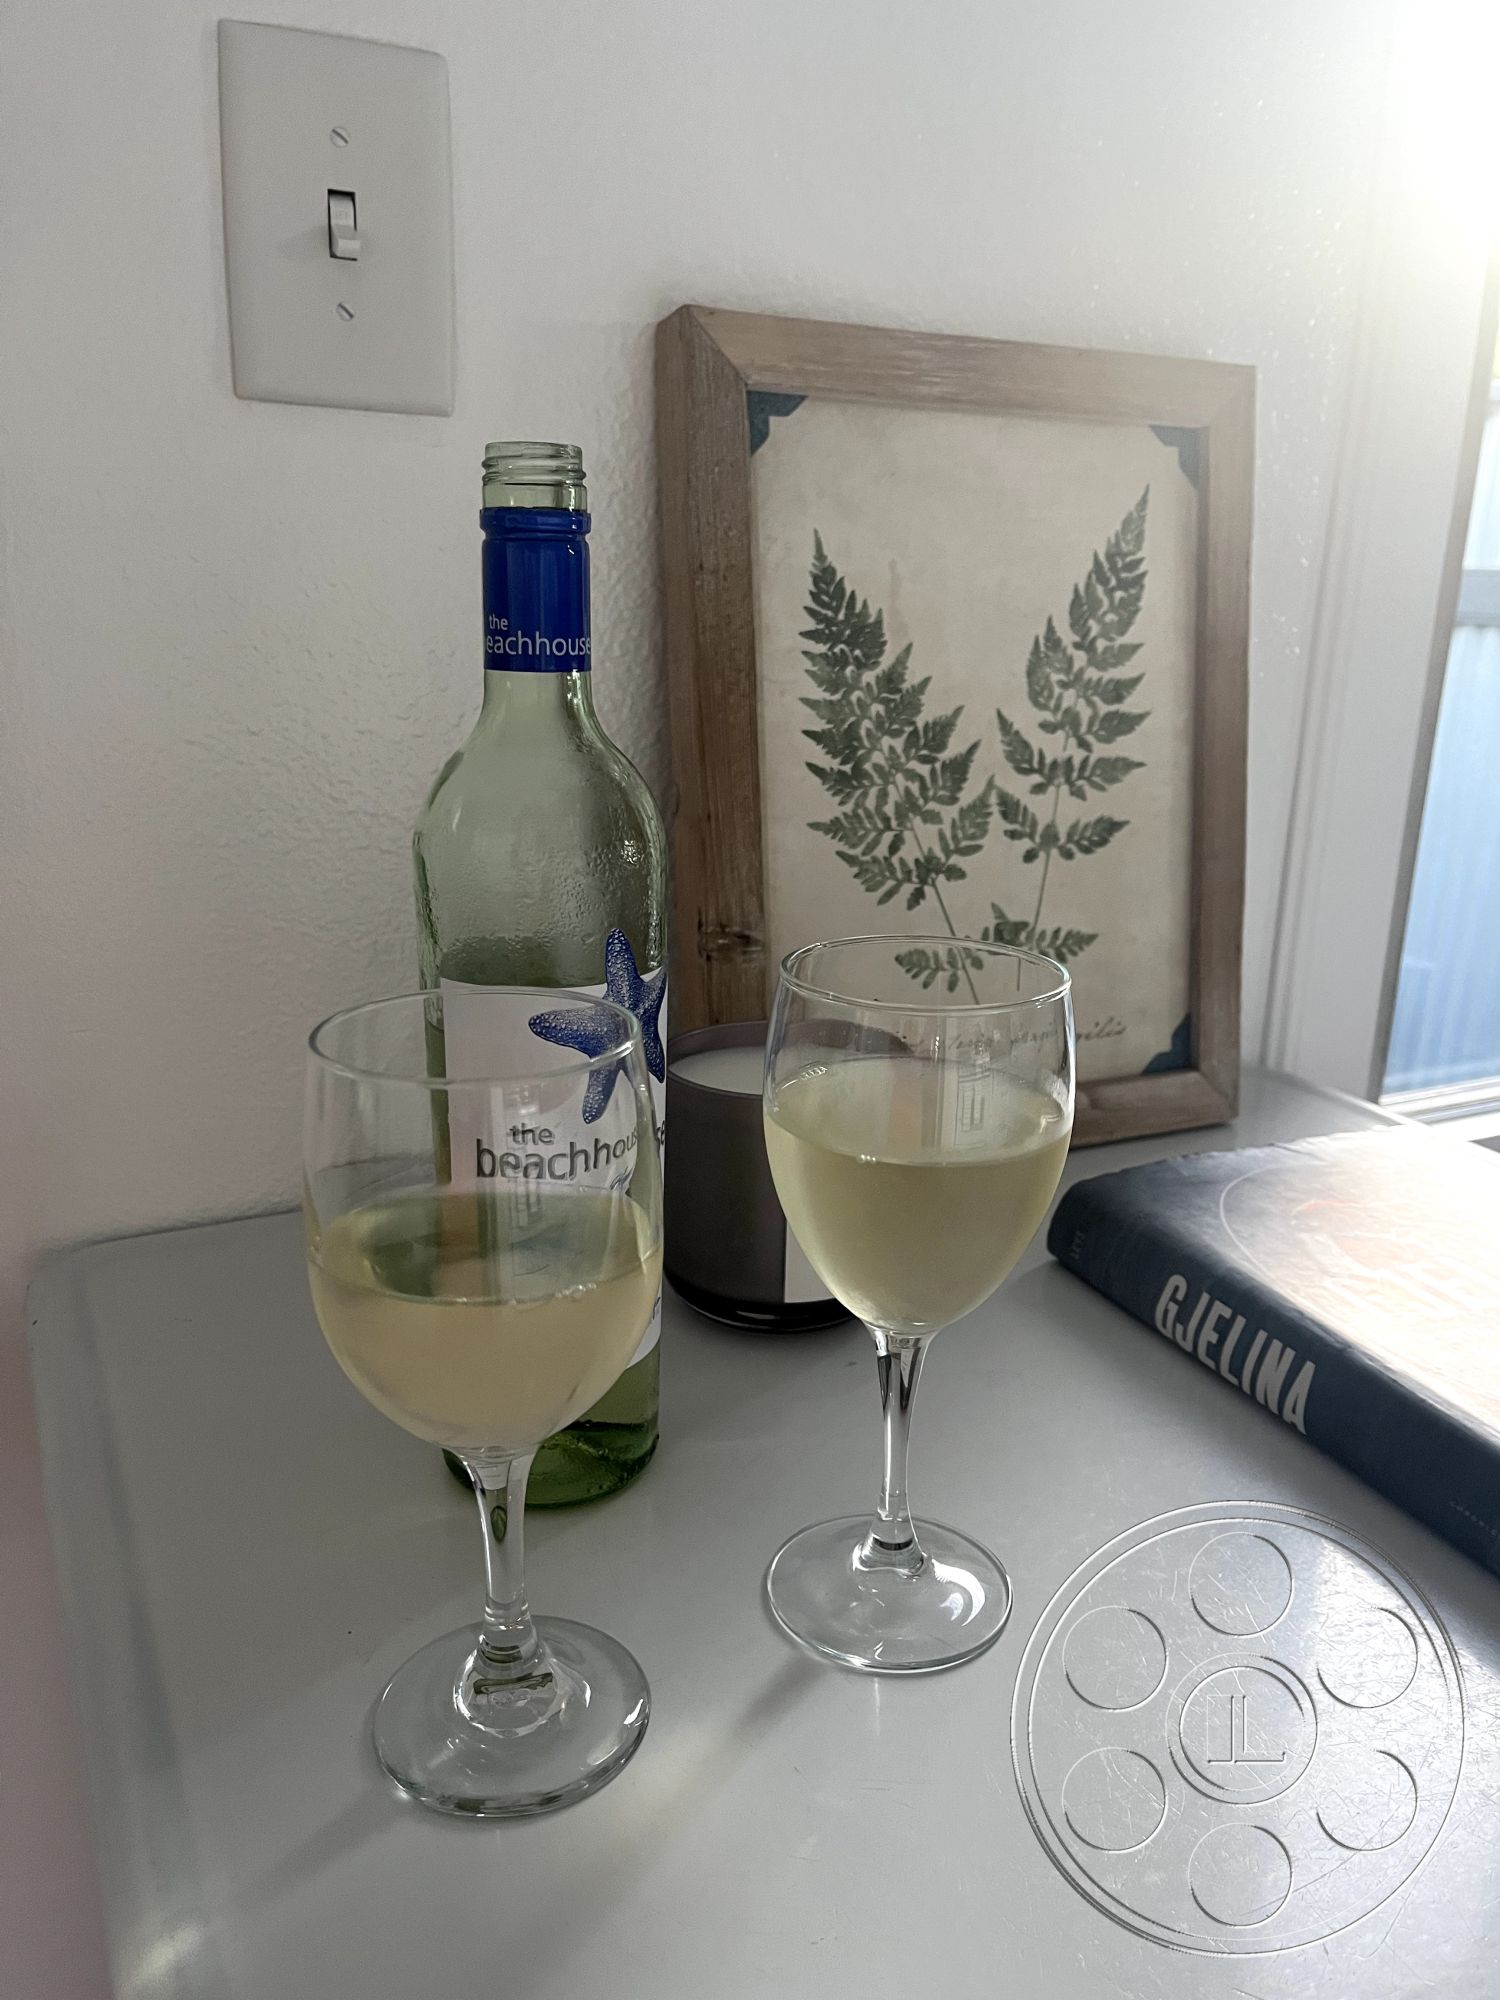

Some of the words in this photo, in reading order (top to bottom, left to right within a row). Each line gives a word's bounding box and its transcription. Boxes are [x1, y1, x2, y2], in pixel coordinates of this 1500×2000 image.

[489, 613, 508, 630] the
[486, 630, 591, 656] eachhouse
[510, 1123, 555, 1145] the
[1154, 1274, 1317, 1436] GJELINA
